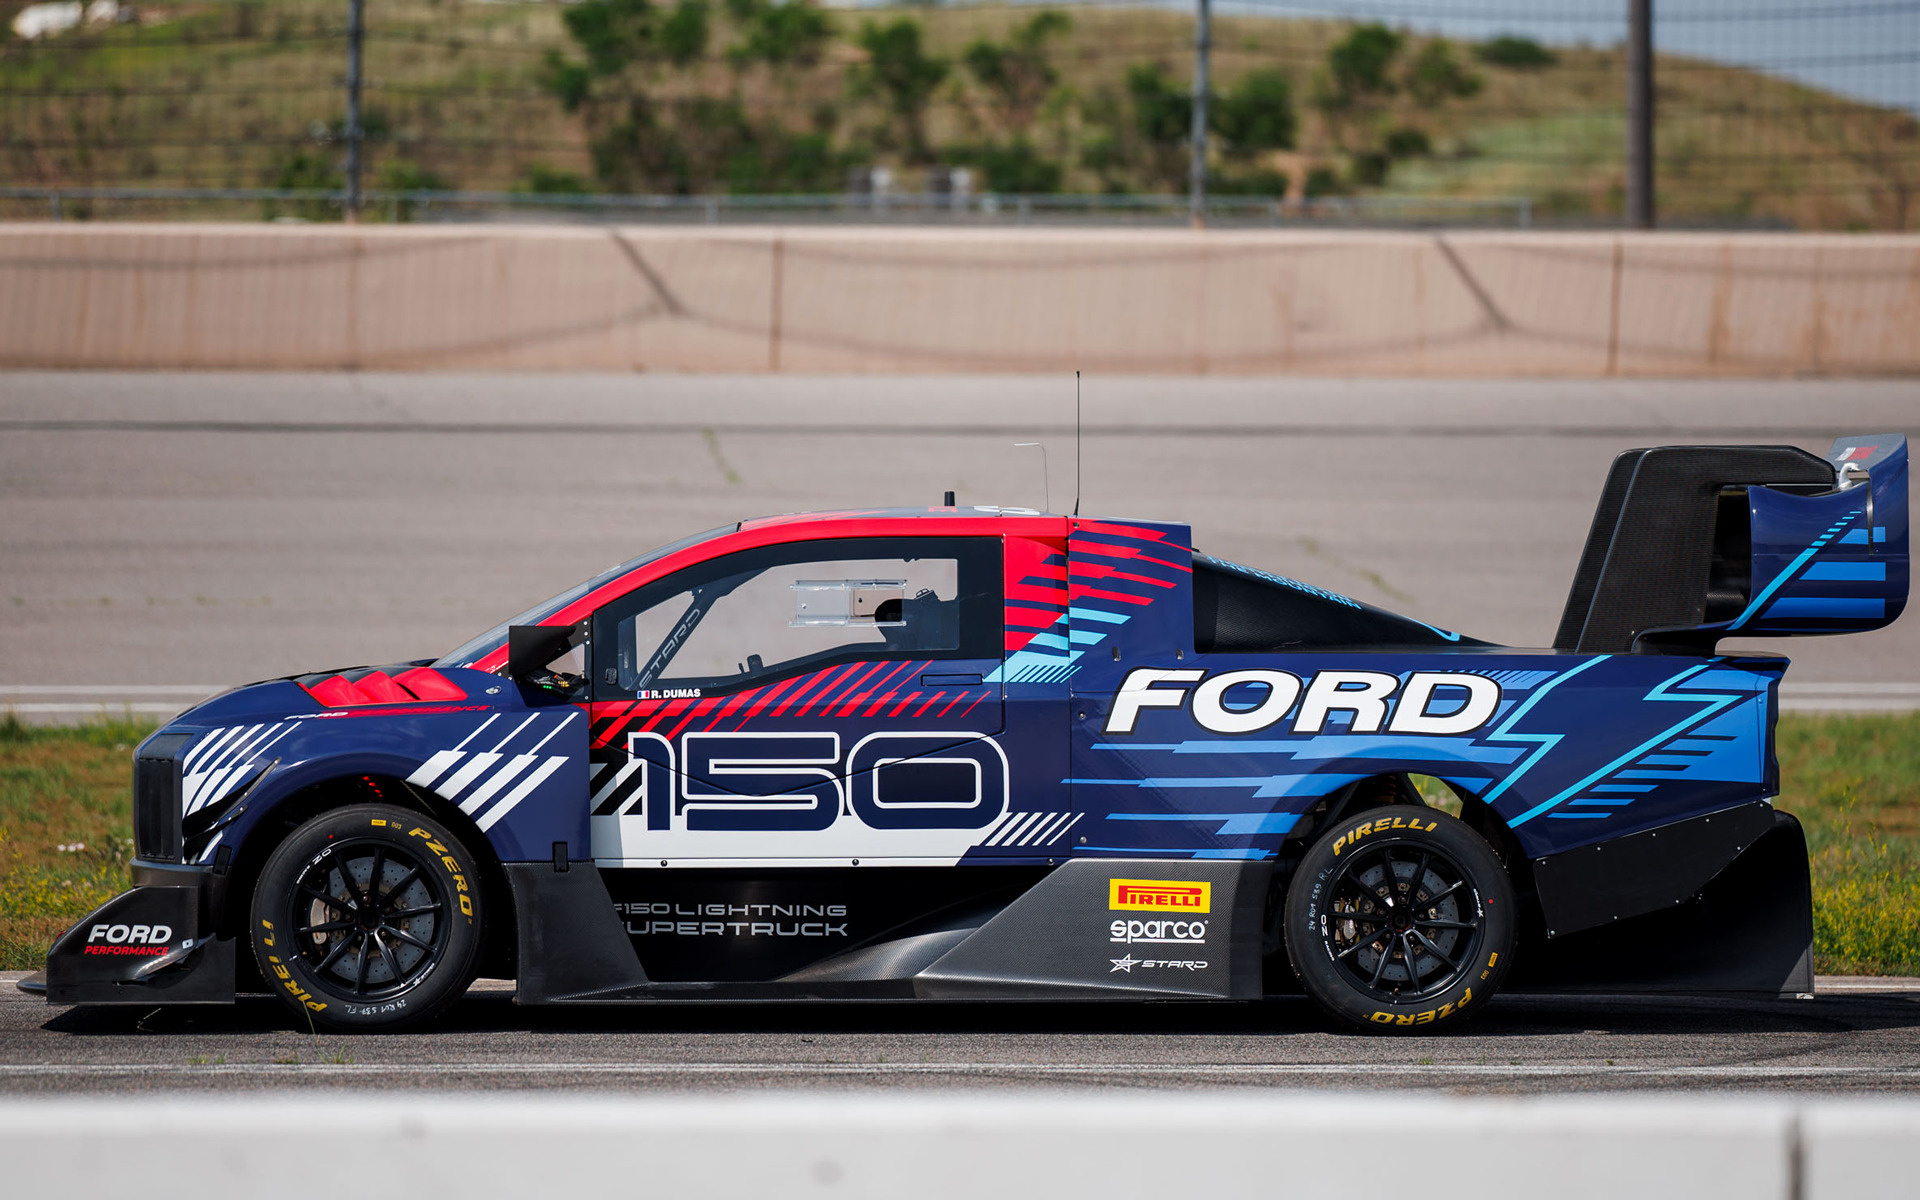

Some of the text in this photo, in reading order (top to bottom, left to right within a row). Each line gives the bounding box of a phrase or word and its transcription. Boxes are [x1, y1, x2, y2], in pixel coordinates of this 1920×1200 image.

[639, 608, 701, 689] STARD
[651, 689, 701, 699] R. DUMAS
[1103, 667, 1500, 736] FORD
[627, 731, 1010, 832] 150
[1332, 817, 1438, 856] PIRELLI
[1118, 885, 1203, 907] PIRELLI
[675, 904, 848, 917] LIGHTNING
[87, 924, 173, 944] FORD
[621, 921, 848, 937] UPERTRUCK
[1110, 920, 1206, 944] sparco
[84, 945, 170, 956] PERFORMANCE
[1141, 960, 1208, 972] STARD
